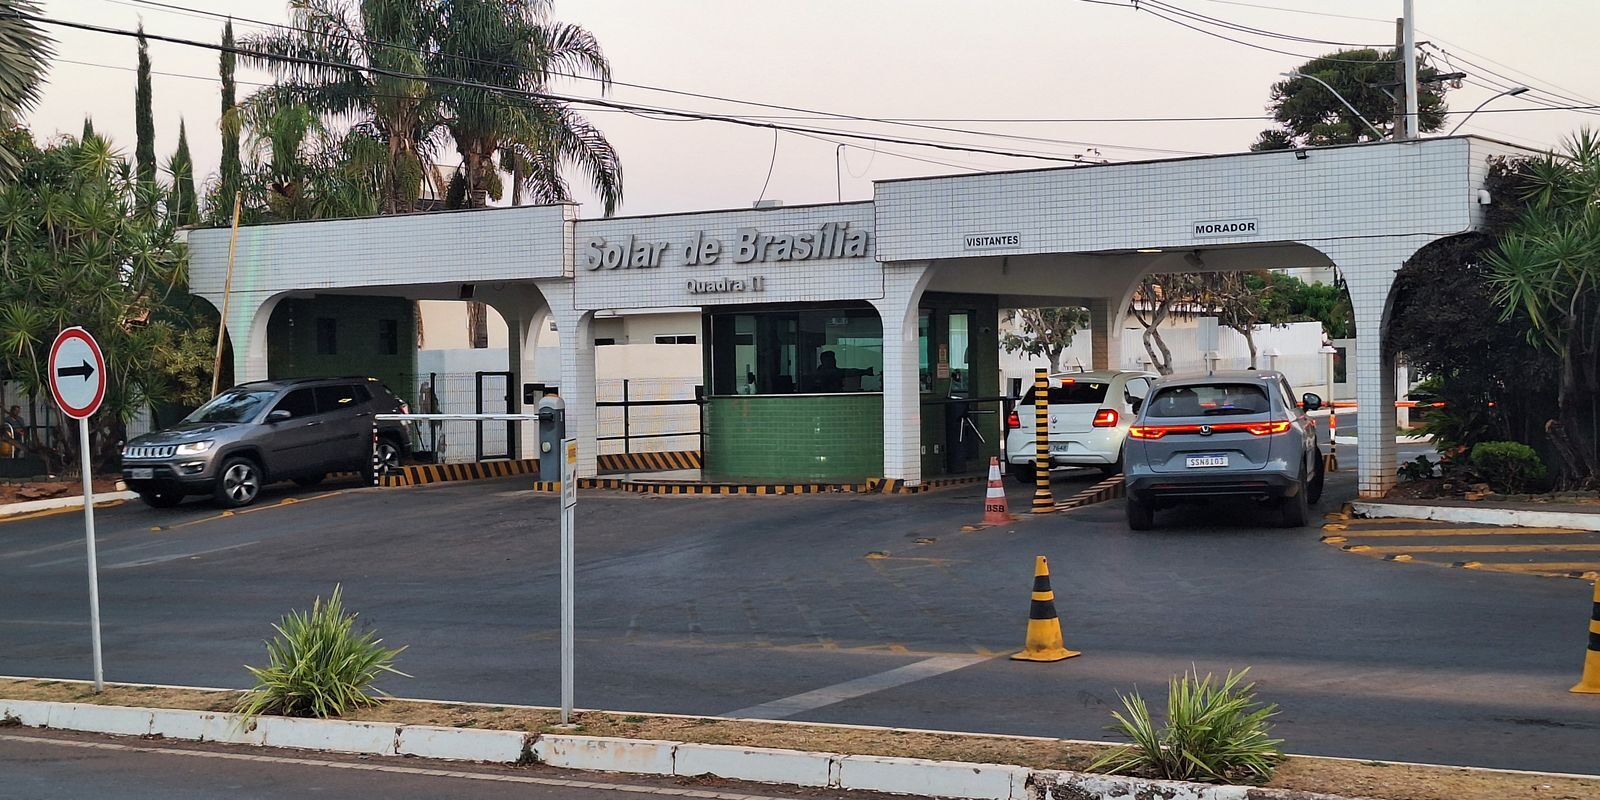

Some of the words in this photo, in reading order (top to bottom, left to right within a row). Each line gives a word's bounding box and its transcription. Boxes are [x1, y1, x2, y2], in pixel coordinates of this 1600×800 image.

[1195, 222, 1256, 235] MORADOR
[585, 234, 669, 271] Solar
[680, 230, 721, 266] de
[733, 221, 869, 264] Brasília
[966, 235, 1019, 247] VISITANTES
[686, 277, 744, 294] Quadra
[986, 504, 1005, 513] BSB
